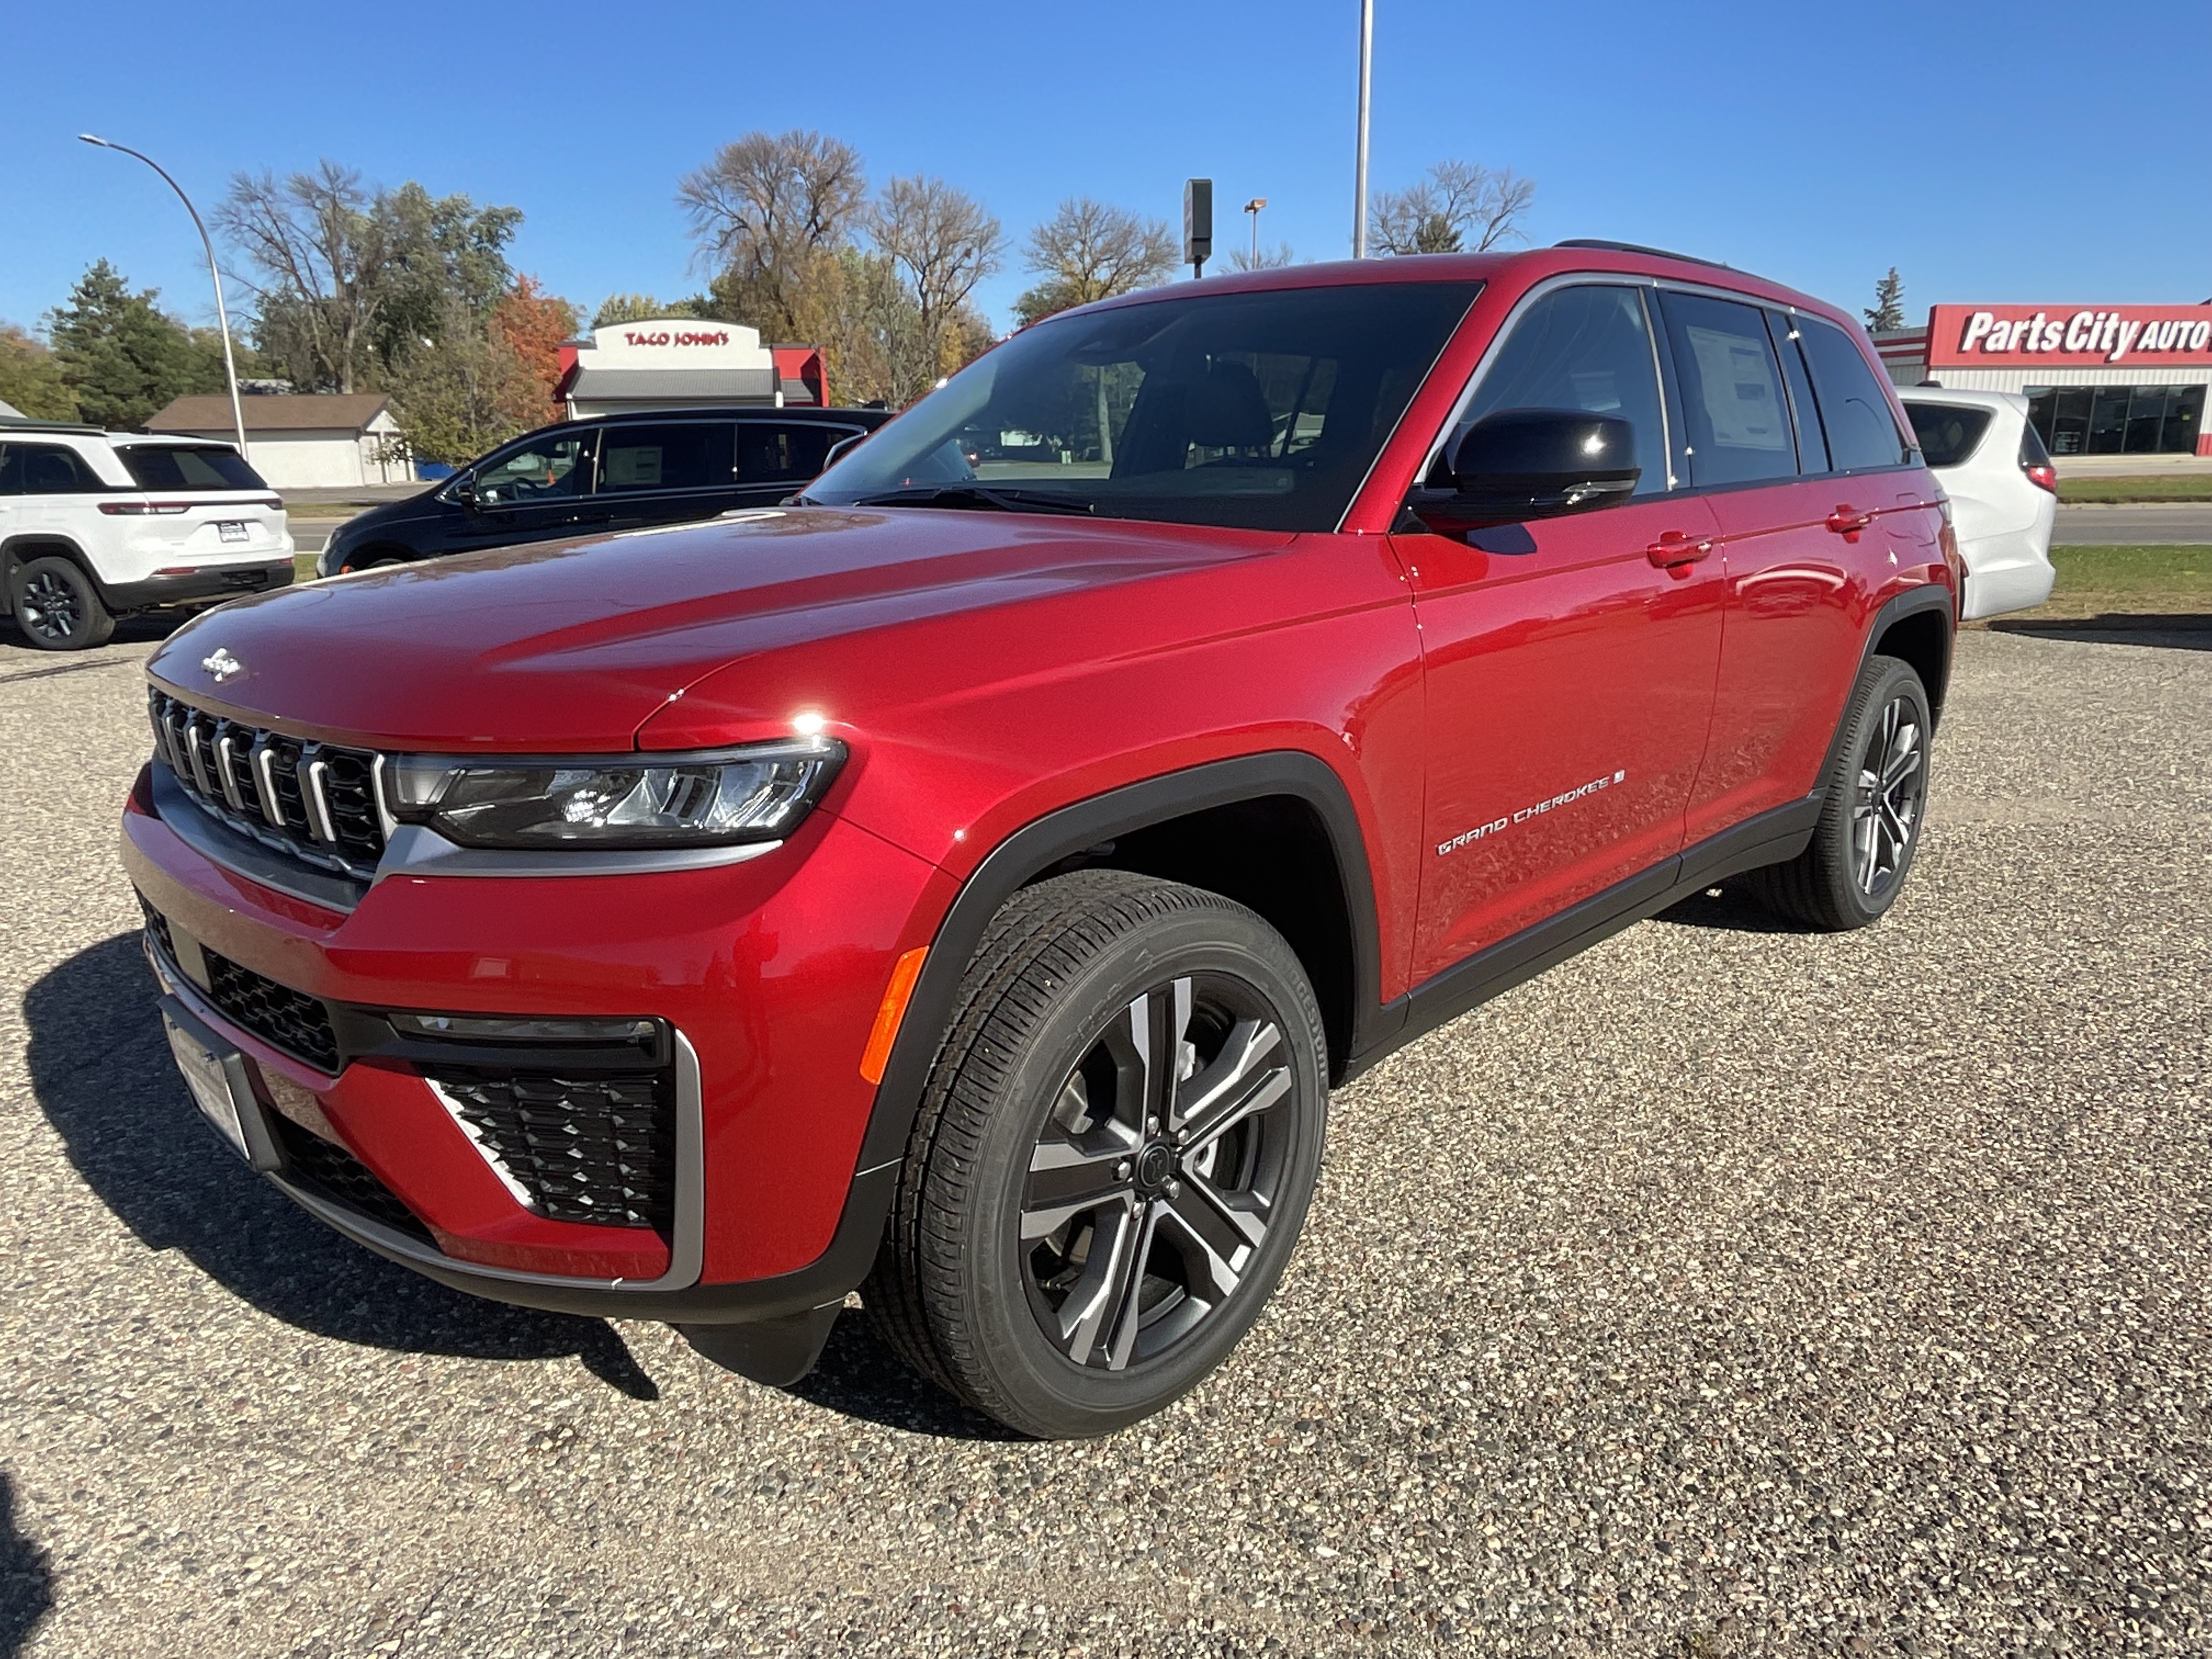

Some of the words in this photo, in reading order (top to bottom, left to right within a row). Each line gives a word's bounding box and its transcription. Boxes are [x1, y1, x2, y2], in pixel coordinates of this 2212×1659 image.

[624, 332, 670, 346] TACO
[673, 330, 729, 347] JOHN'S
[1961, 311, 2140, 362] PartsCity
[2137, 320, 2210, 351] AUTO
[1437, 817, 1508, 856] GRAND
[1513, 776, 1610, 824] CHEROKEE
